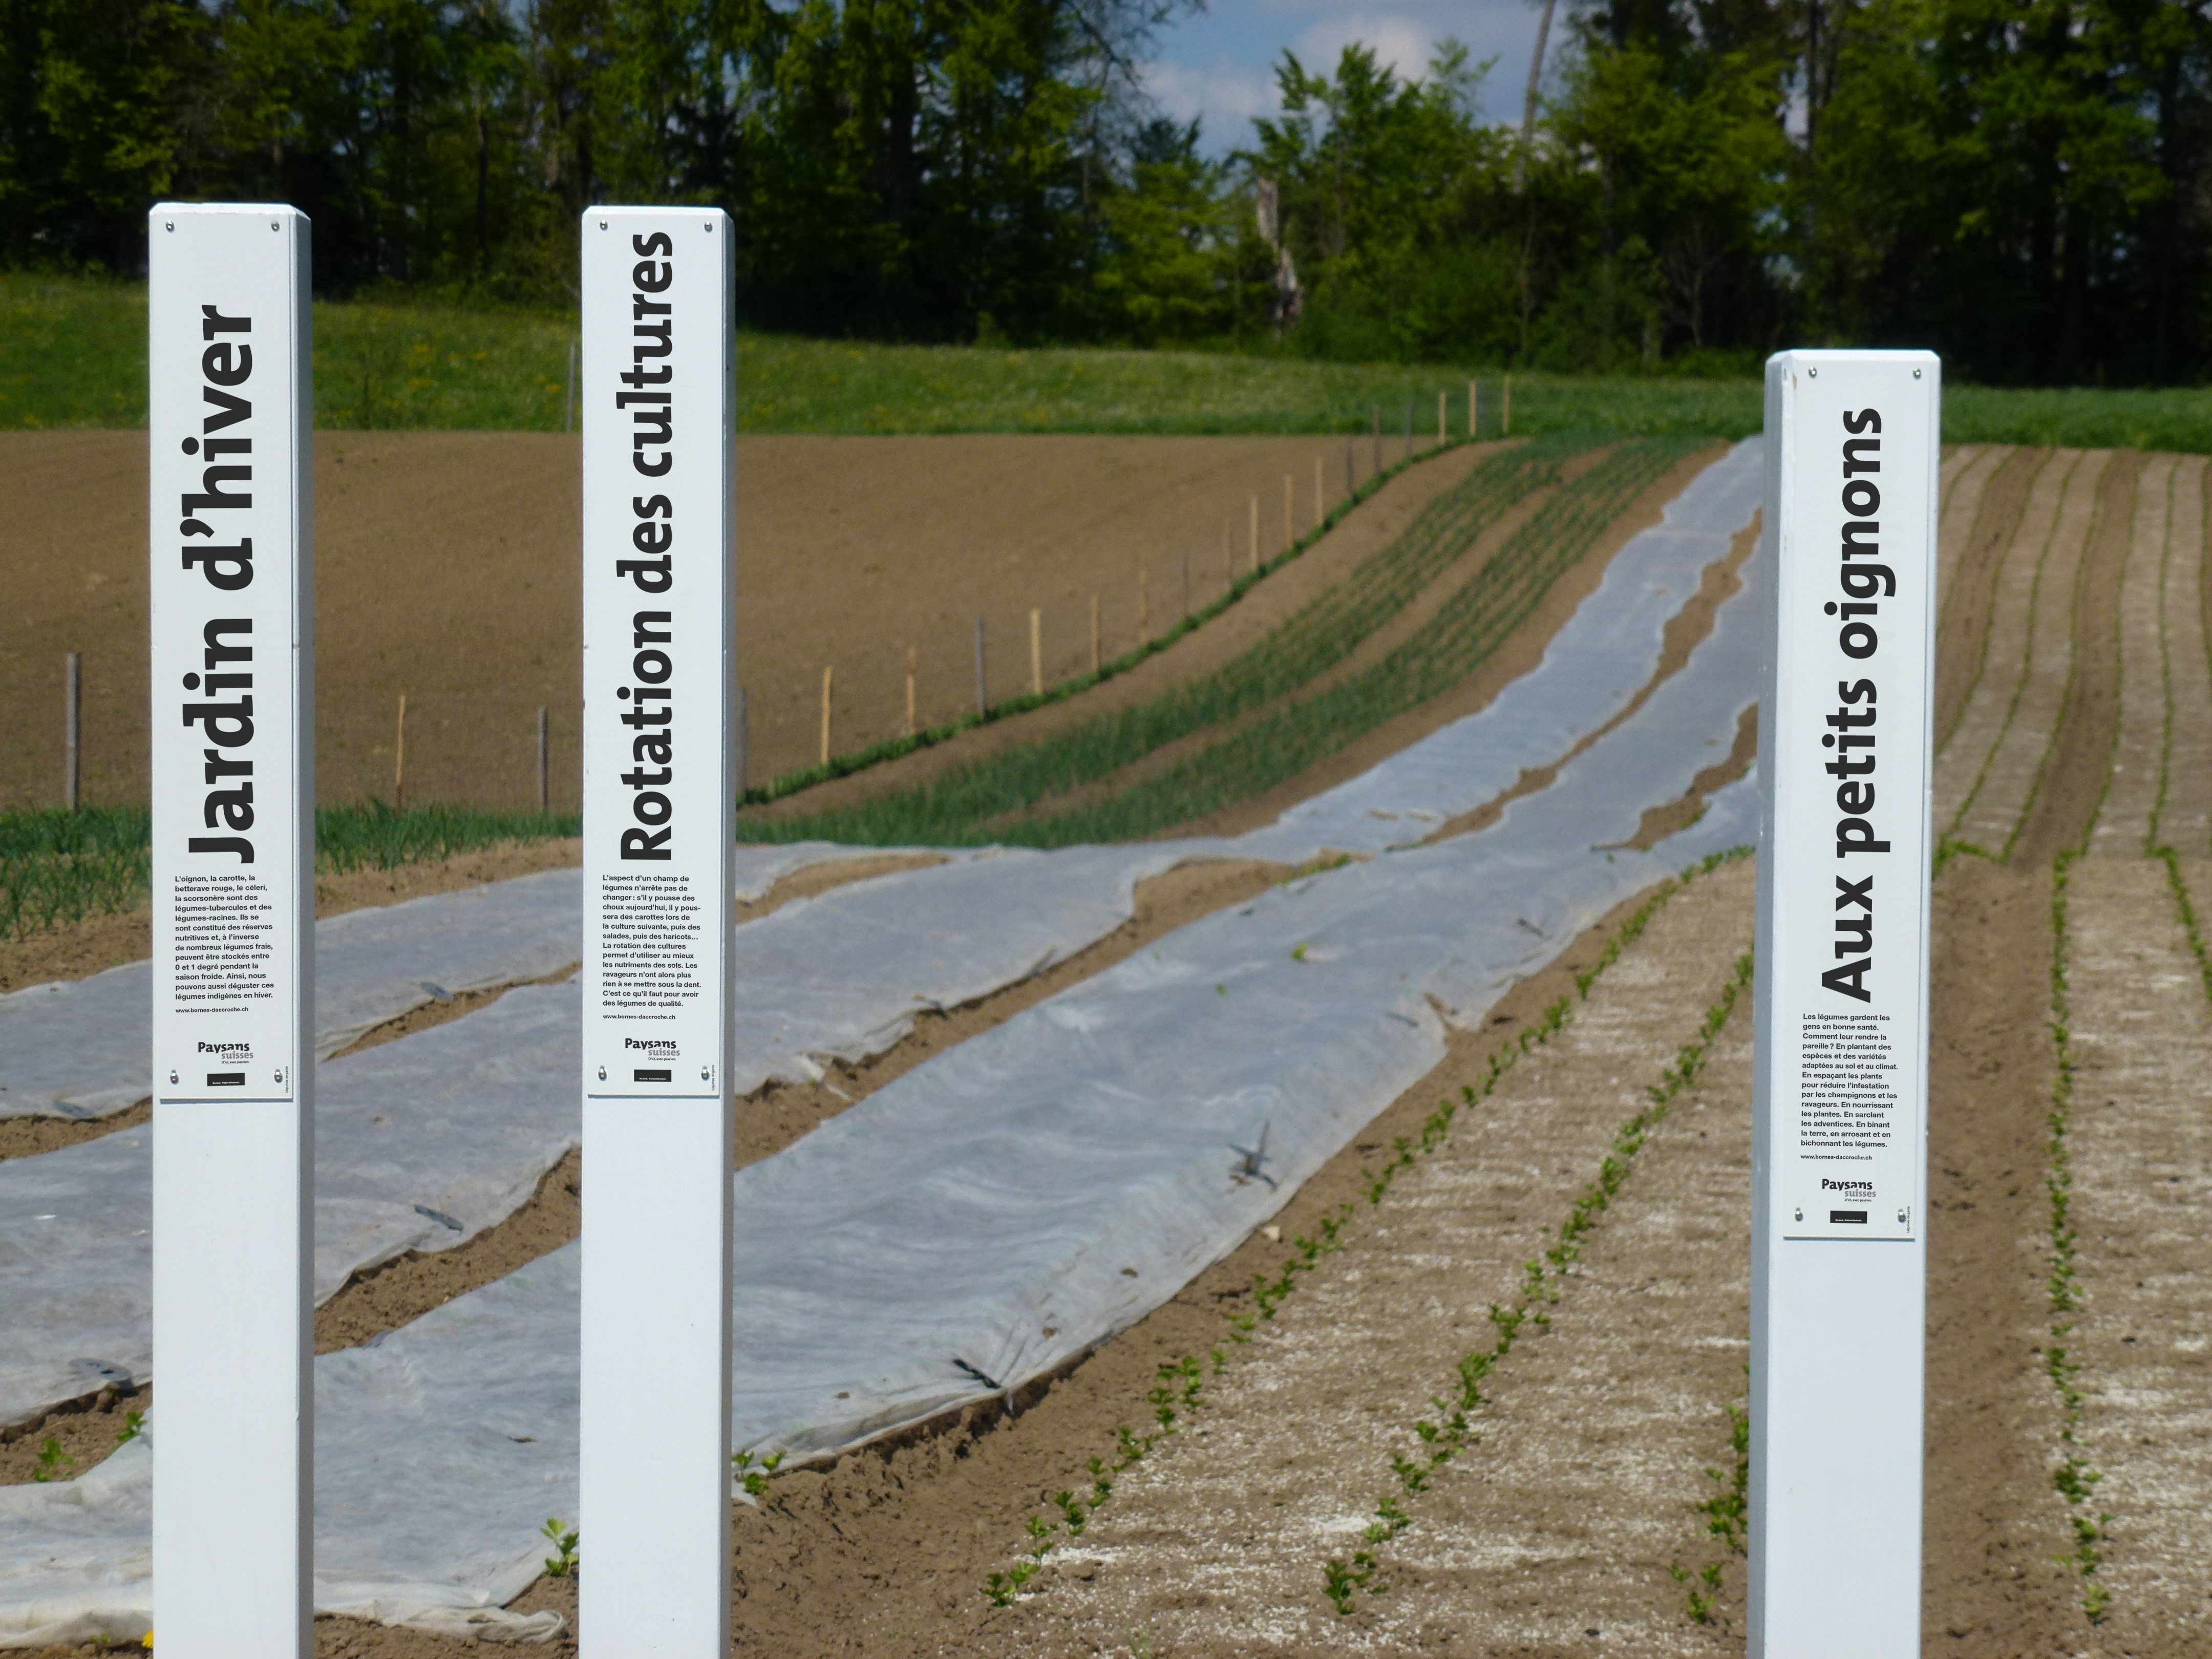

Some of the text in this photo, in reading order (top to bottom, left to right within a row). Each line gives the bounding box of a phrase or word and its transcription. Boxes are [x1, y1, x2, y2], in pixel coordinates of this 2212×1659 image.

[616, 232, 673, 860] Rotation des cultures
[180, 305, 254, 864] Jardin d’hiver
[1821, 408, 1896, 1004] Aux petits oignons
[175, 904, 248, 913] légumes-tubercules
[175, 914, 238, 923] légumes-racines.
[198, 1042, 249, 1053] Paysans
[625, 1038, 676, 1050] Paysans
[221, 1051, 253, 1059] suisses
[648, 1048, 680, 1056] suisses
[1822, 1179, 1873, 1191] Paysans
[1844, 1189, 1876, 1197] suisses
